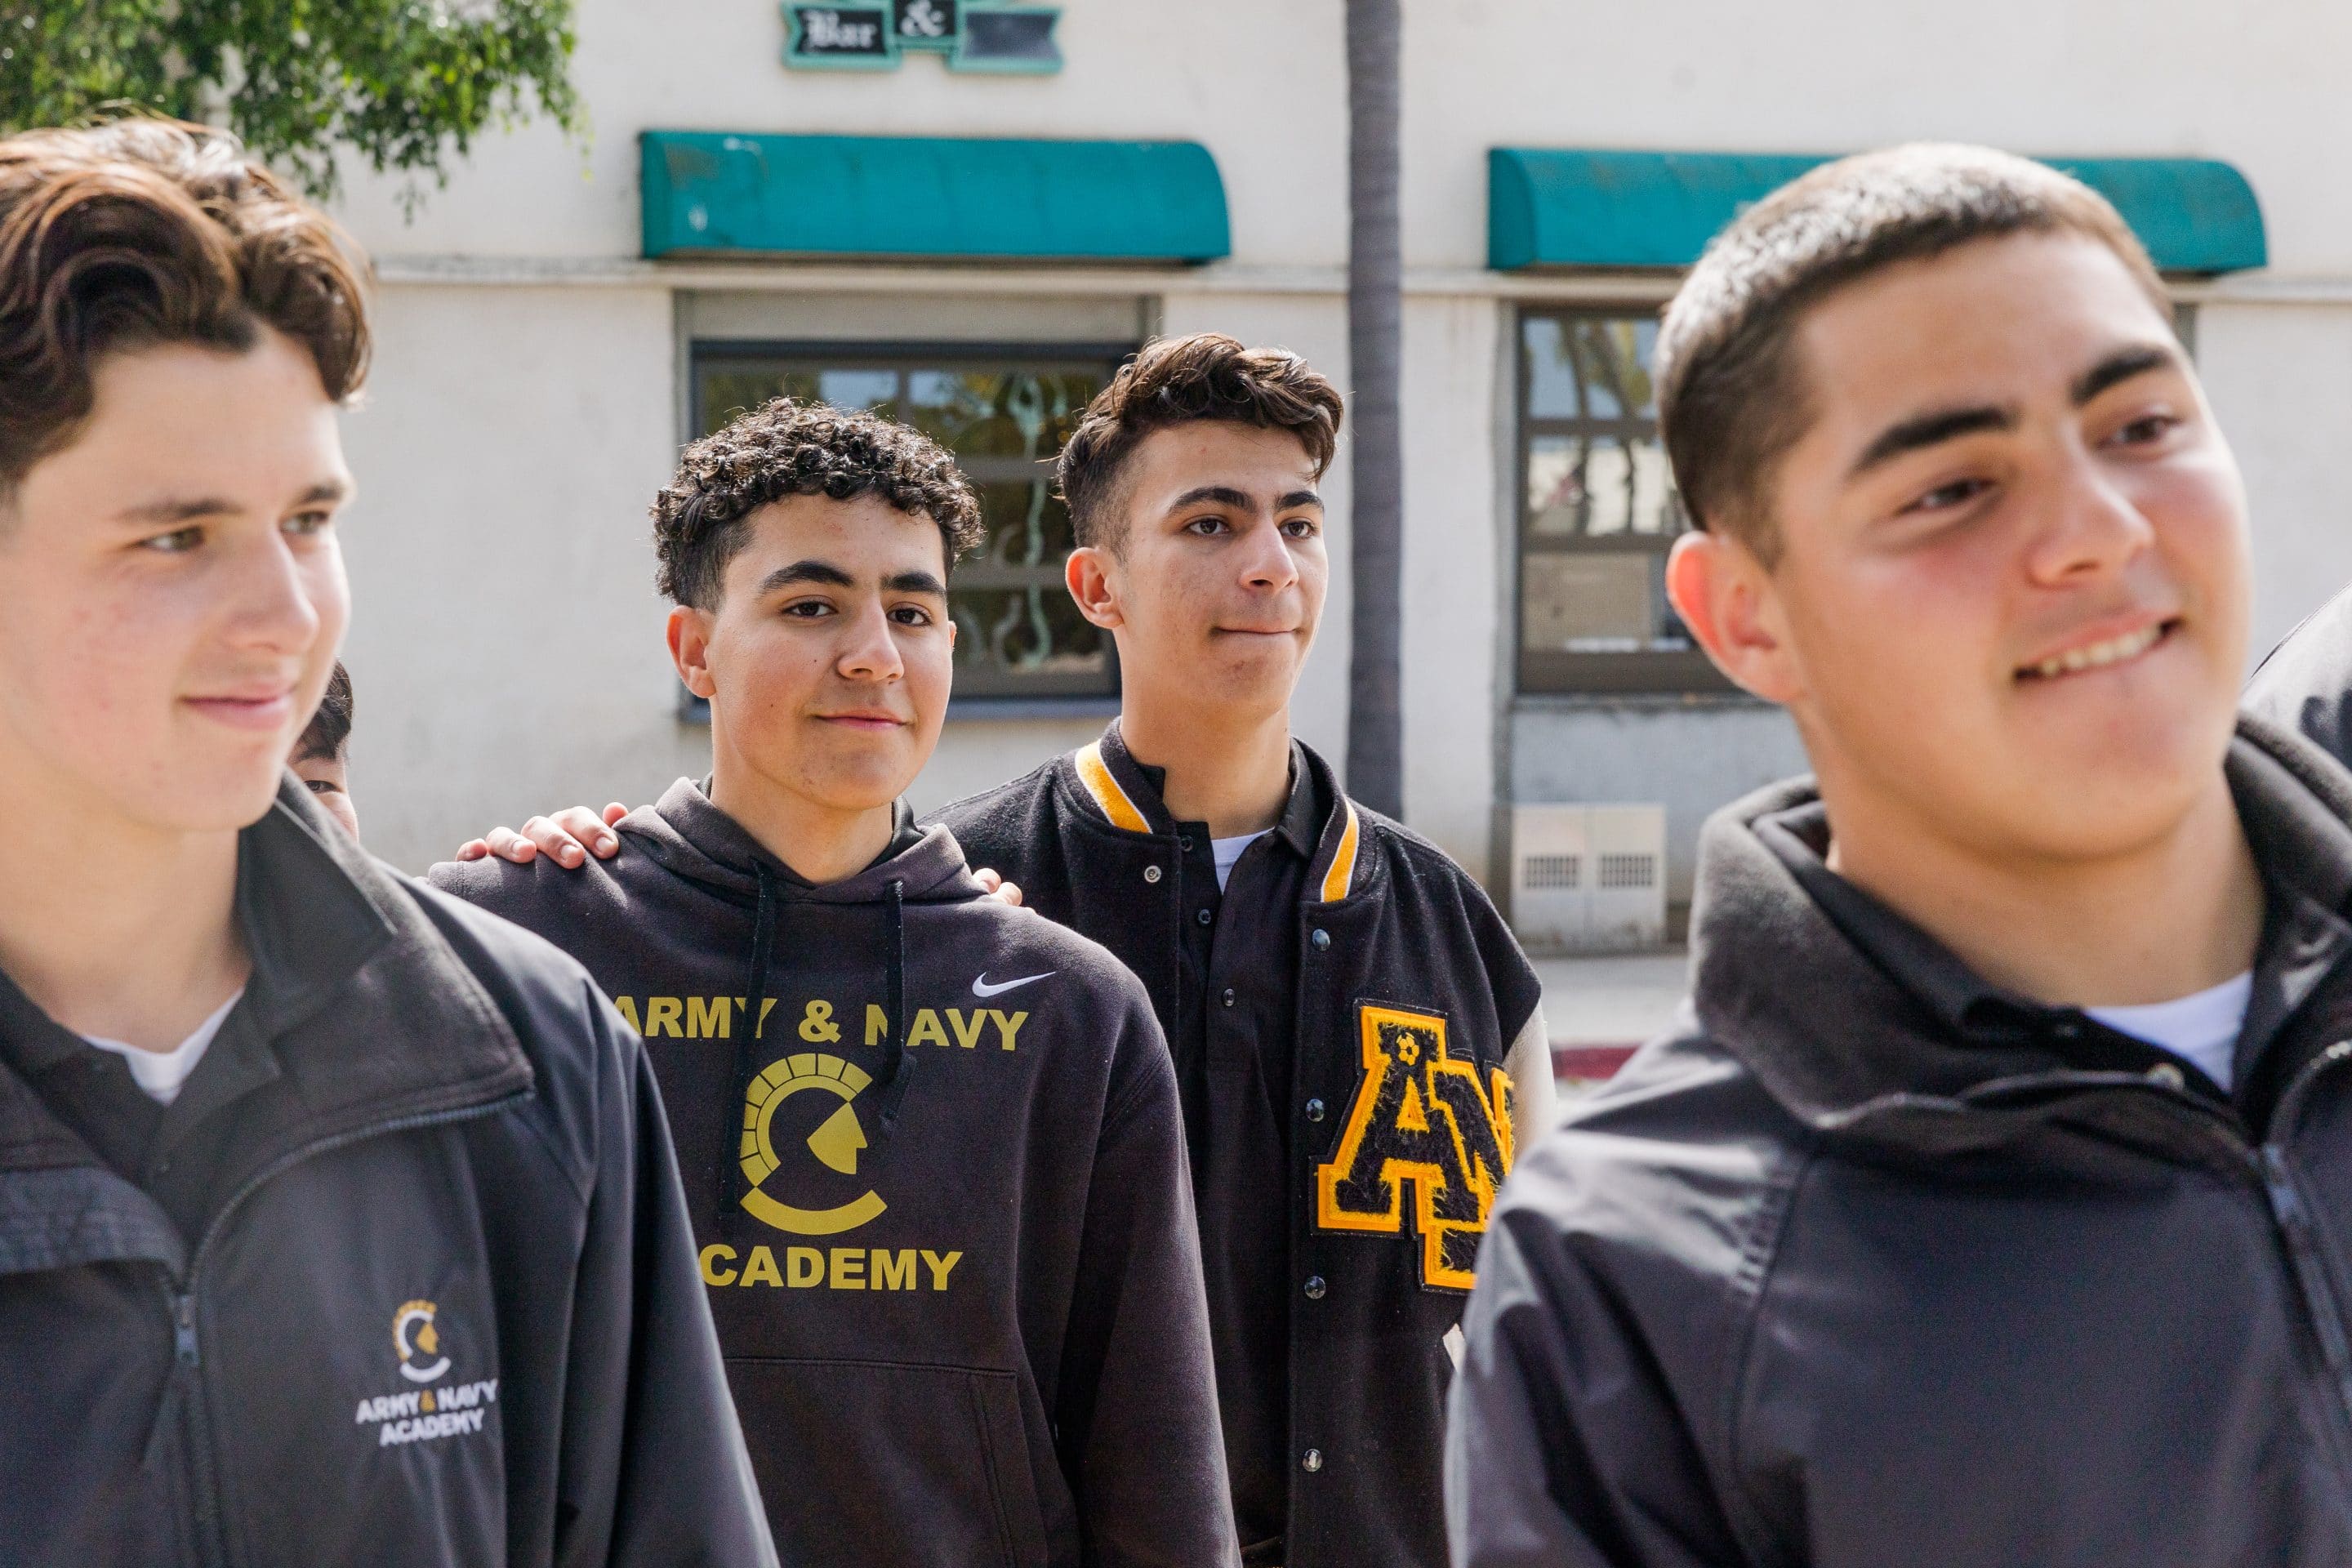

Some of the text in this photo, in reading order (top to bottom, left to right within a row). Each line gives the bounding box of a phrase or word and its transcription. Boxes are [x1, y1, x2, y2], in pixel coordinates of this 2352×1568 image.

[901, 0, 945, 38] &
[798, 1000, 842, 1044] &
[697, 1244, 963, 1291] CADEMY
[356, 1392, 421, 1424] ARMY
[436, 1379, 499, 1411] NAVY
[379, 1408, 484, 1446] ACADEMY
